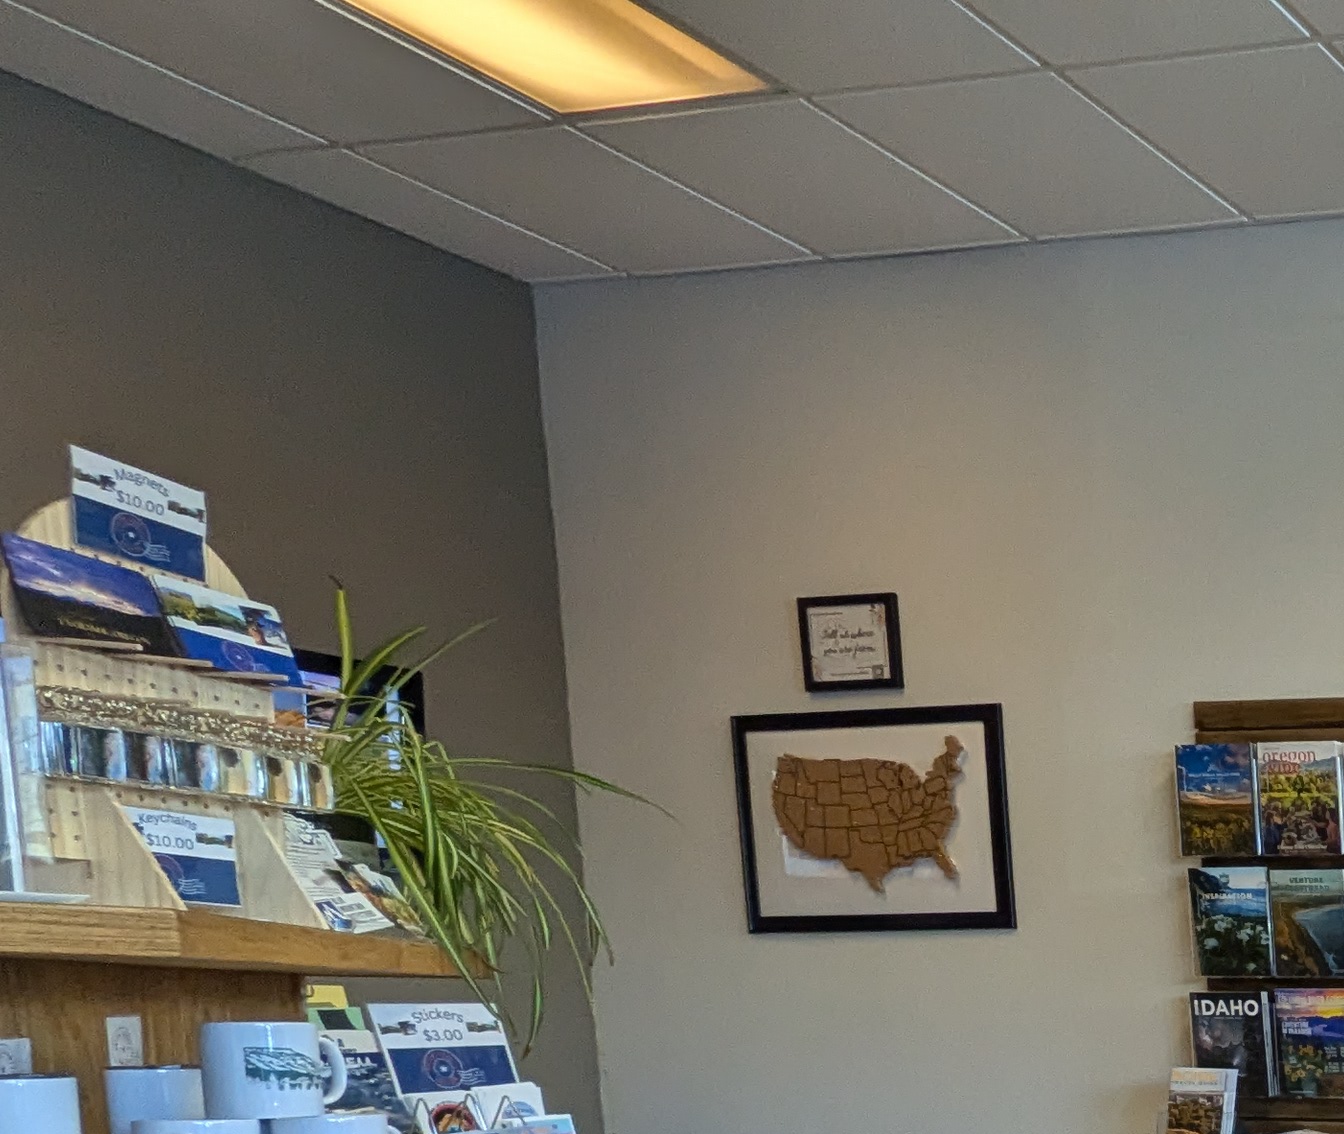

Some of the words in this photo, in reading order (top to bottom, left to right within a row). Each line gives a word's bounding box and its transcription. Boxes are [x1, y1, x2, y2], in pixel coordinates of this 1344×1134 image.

[114, 468, 170, 497] Magnets
[116, 490, 165, 515] $10.00
[138, 812, 197, 832] Keychains
[146, 834, 194, 851] $10.00
[411, 1008, 464, 1023] Stickers
[1194, 999, 1259, 1016] IDAHO
[424, 1029, 463, 1042] $3.00
